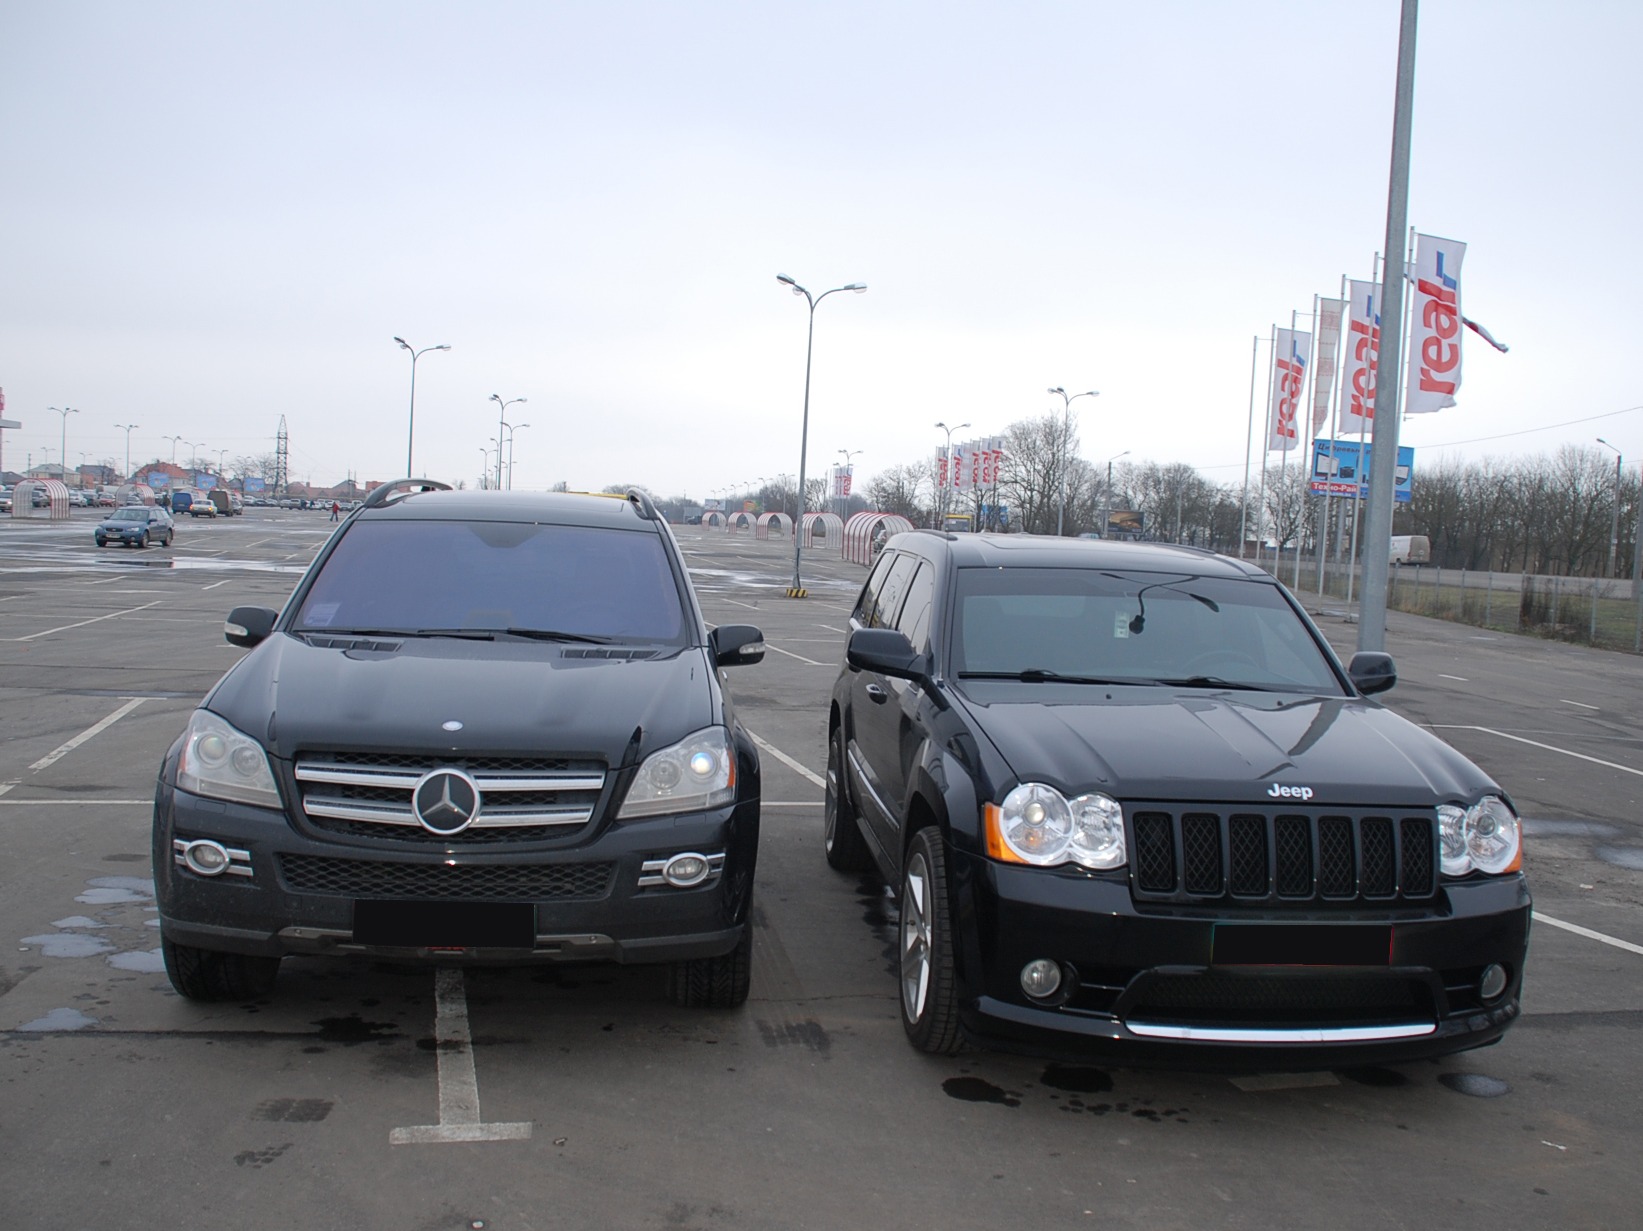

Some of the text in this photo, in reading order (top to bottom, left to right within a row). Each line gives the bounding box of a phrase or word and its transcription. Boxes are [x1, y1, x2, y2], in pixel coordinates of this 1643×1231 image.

[1417, 278, 1459, 395] real
[1276, 358, 1304, 438] real
[1267, 783, 1313, 800] Jeep
